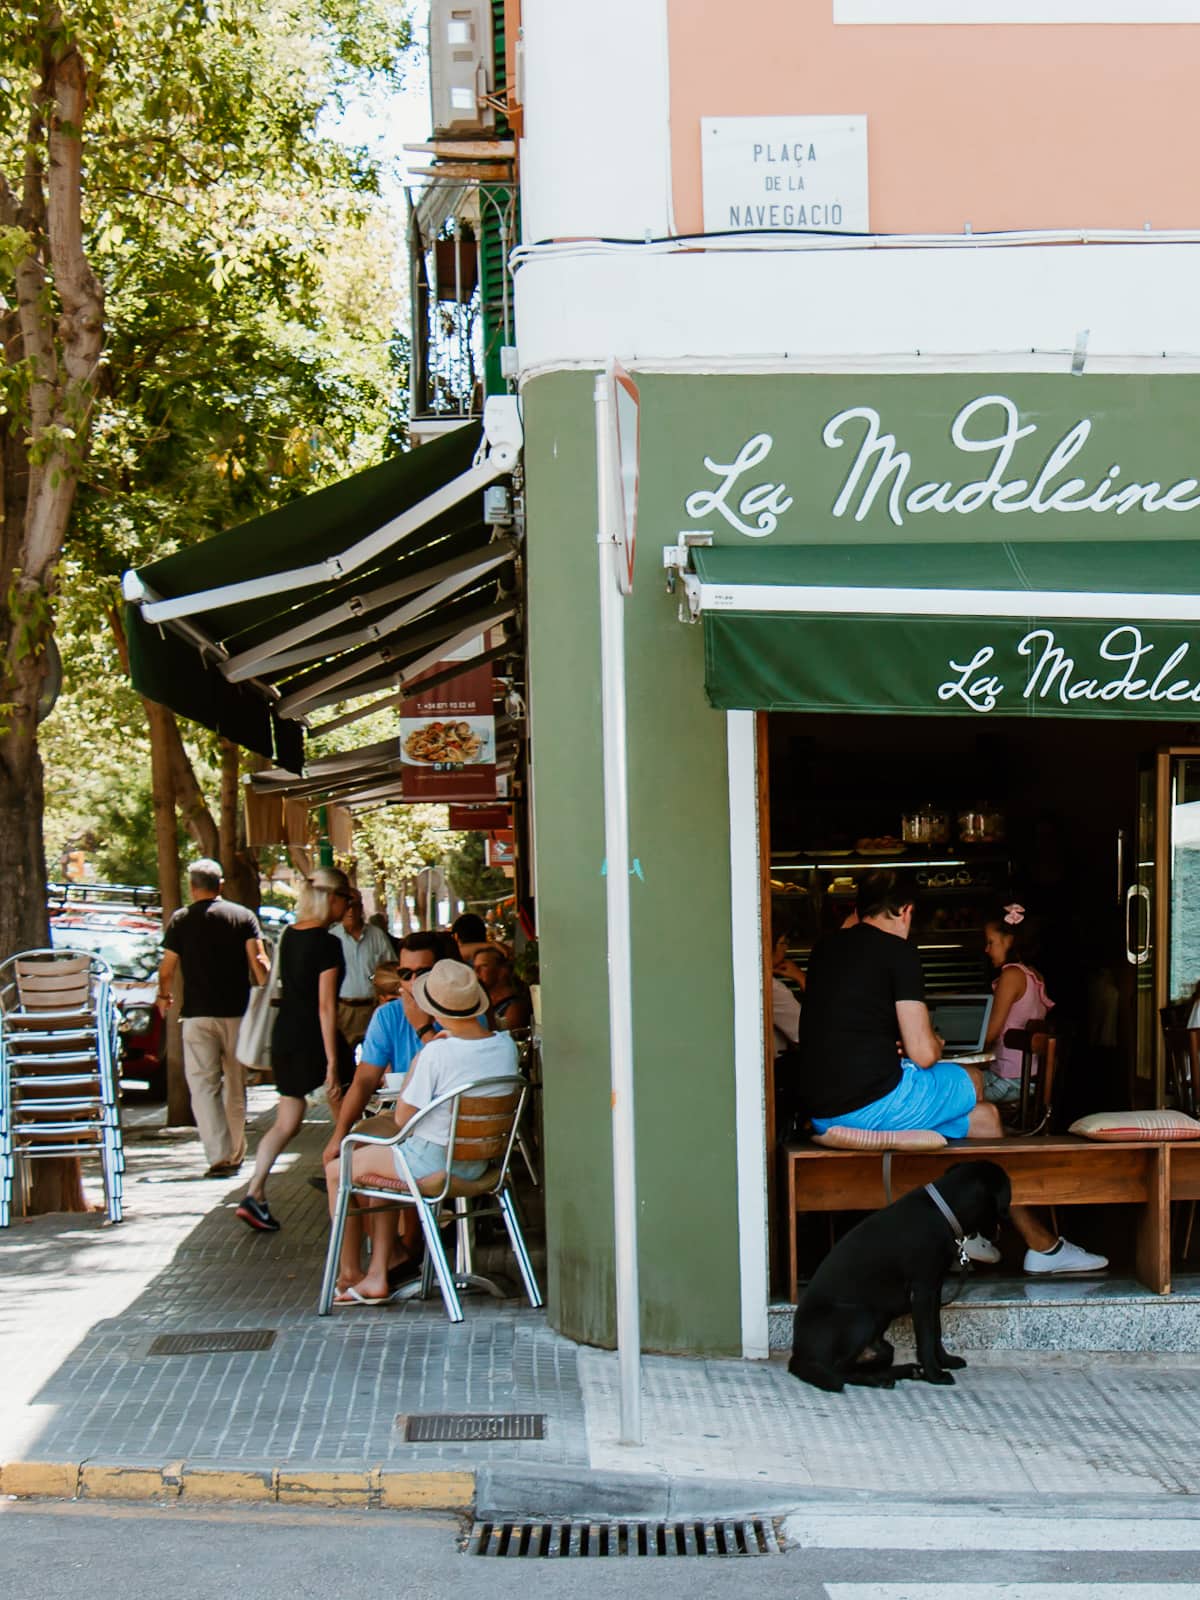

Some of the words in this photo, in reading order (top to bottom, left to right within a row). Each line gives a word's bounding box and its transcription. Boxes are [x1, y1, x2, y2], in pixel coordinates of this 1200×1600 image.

[753, 142, 817, 168] PLAÇA
[765, 176, 782, 191] DE
[788, 176, 805, 191] LA
[684, 433, 794, 538] La
[938, 645, 1004, 713] La
